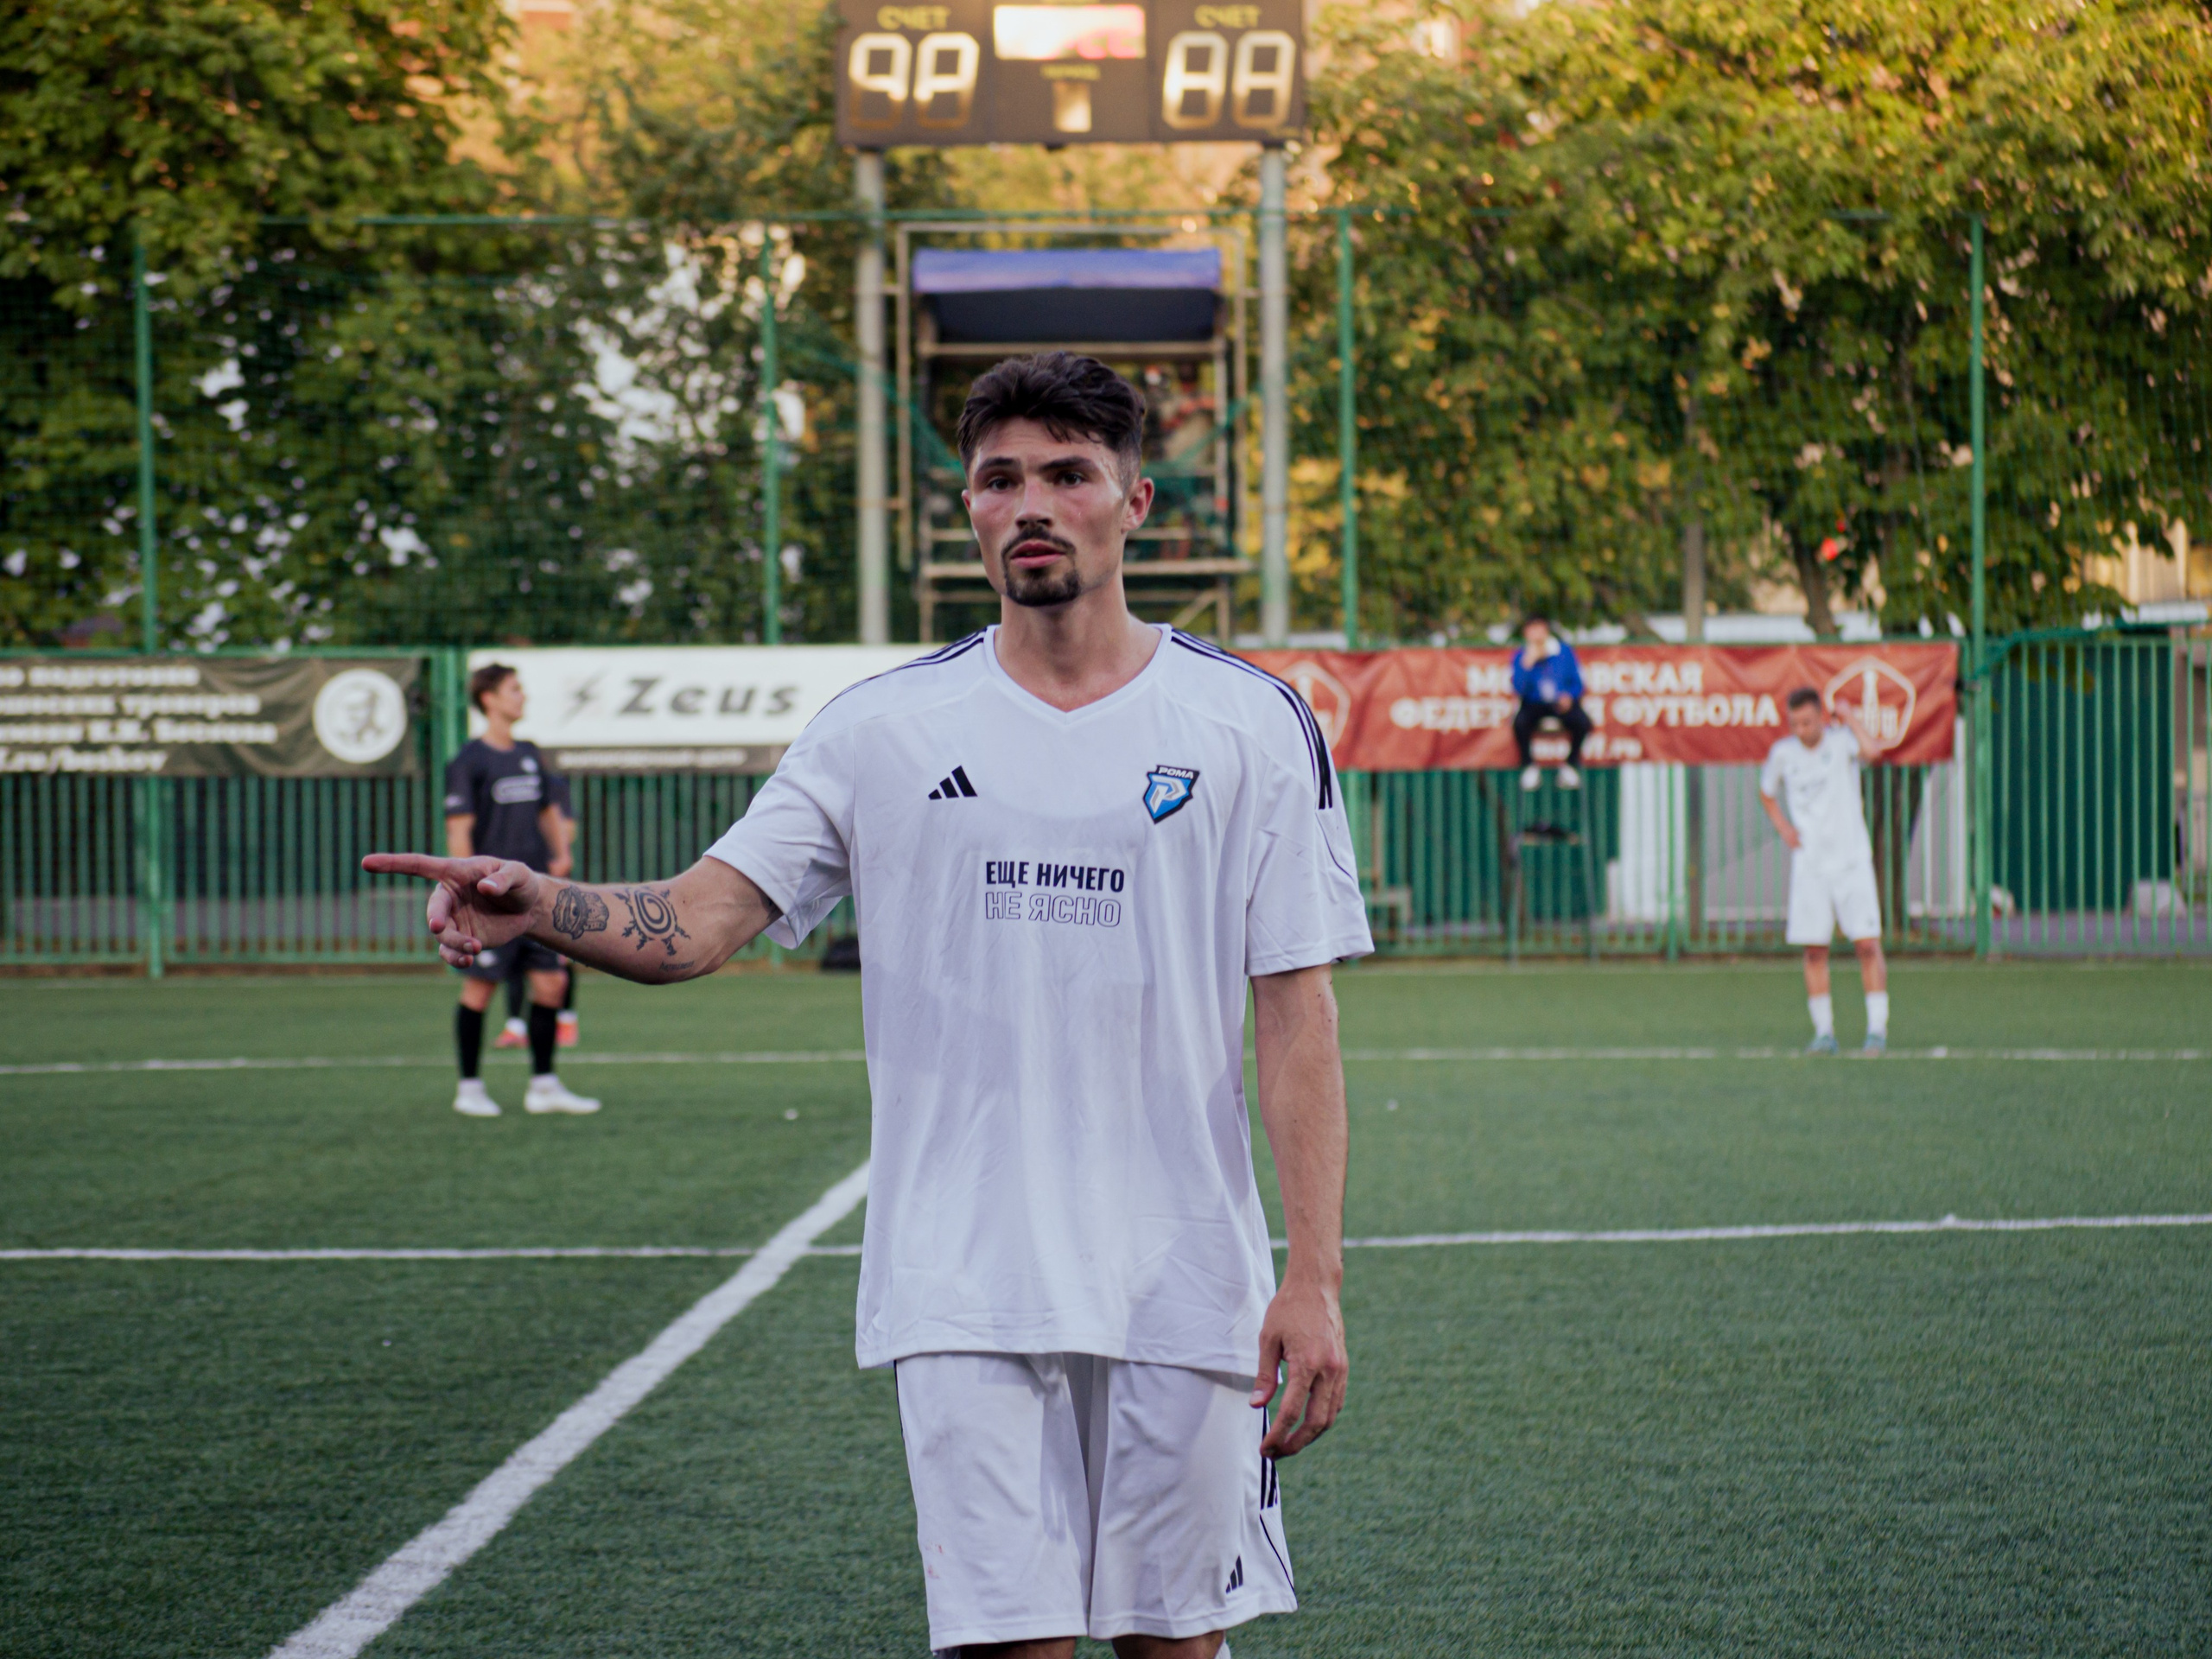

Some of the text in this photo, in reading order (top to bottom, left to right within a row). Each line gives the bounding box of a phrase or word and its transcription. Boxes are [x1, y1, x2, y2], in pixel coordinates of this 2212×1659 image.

[617, 676, 798, 715] Zeus
[1466, 662, 1702, 695] МВСКАЯ
[1389, 693, 1780, 734] ФЕДЕРЯ ФУТБОЛА
[1158, 766, 1194, 780] РОМА
[985, 861, 1125, 893] ЕЩЕ НИЧЕГО
[985, 892, 1122, 927] НЕ ЯСНО
